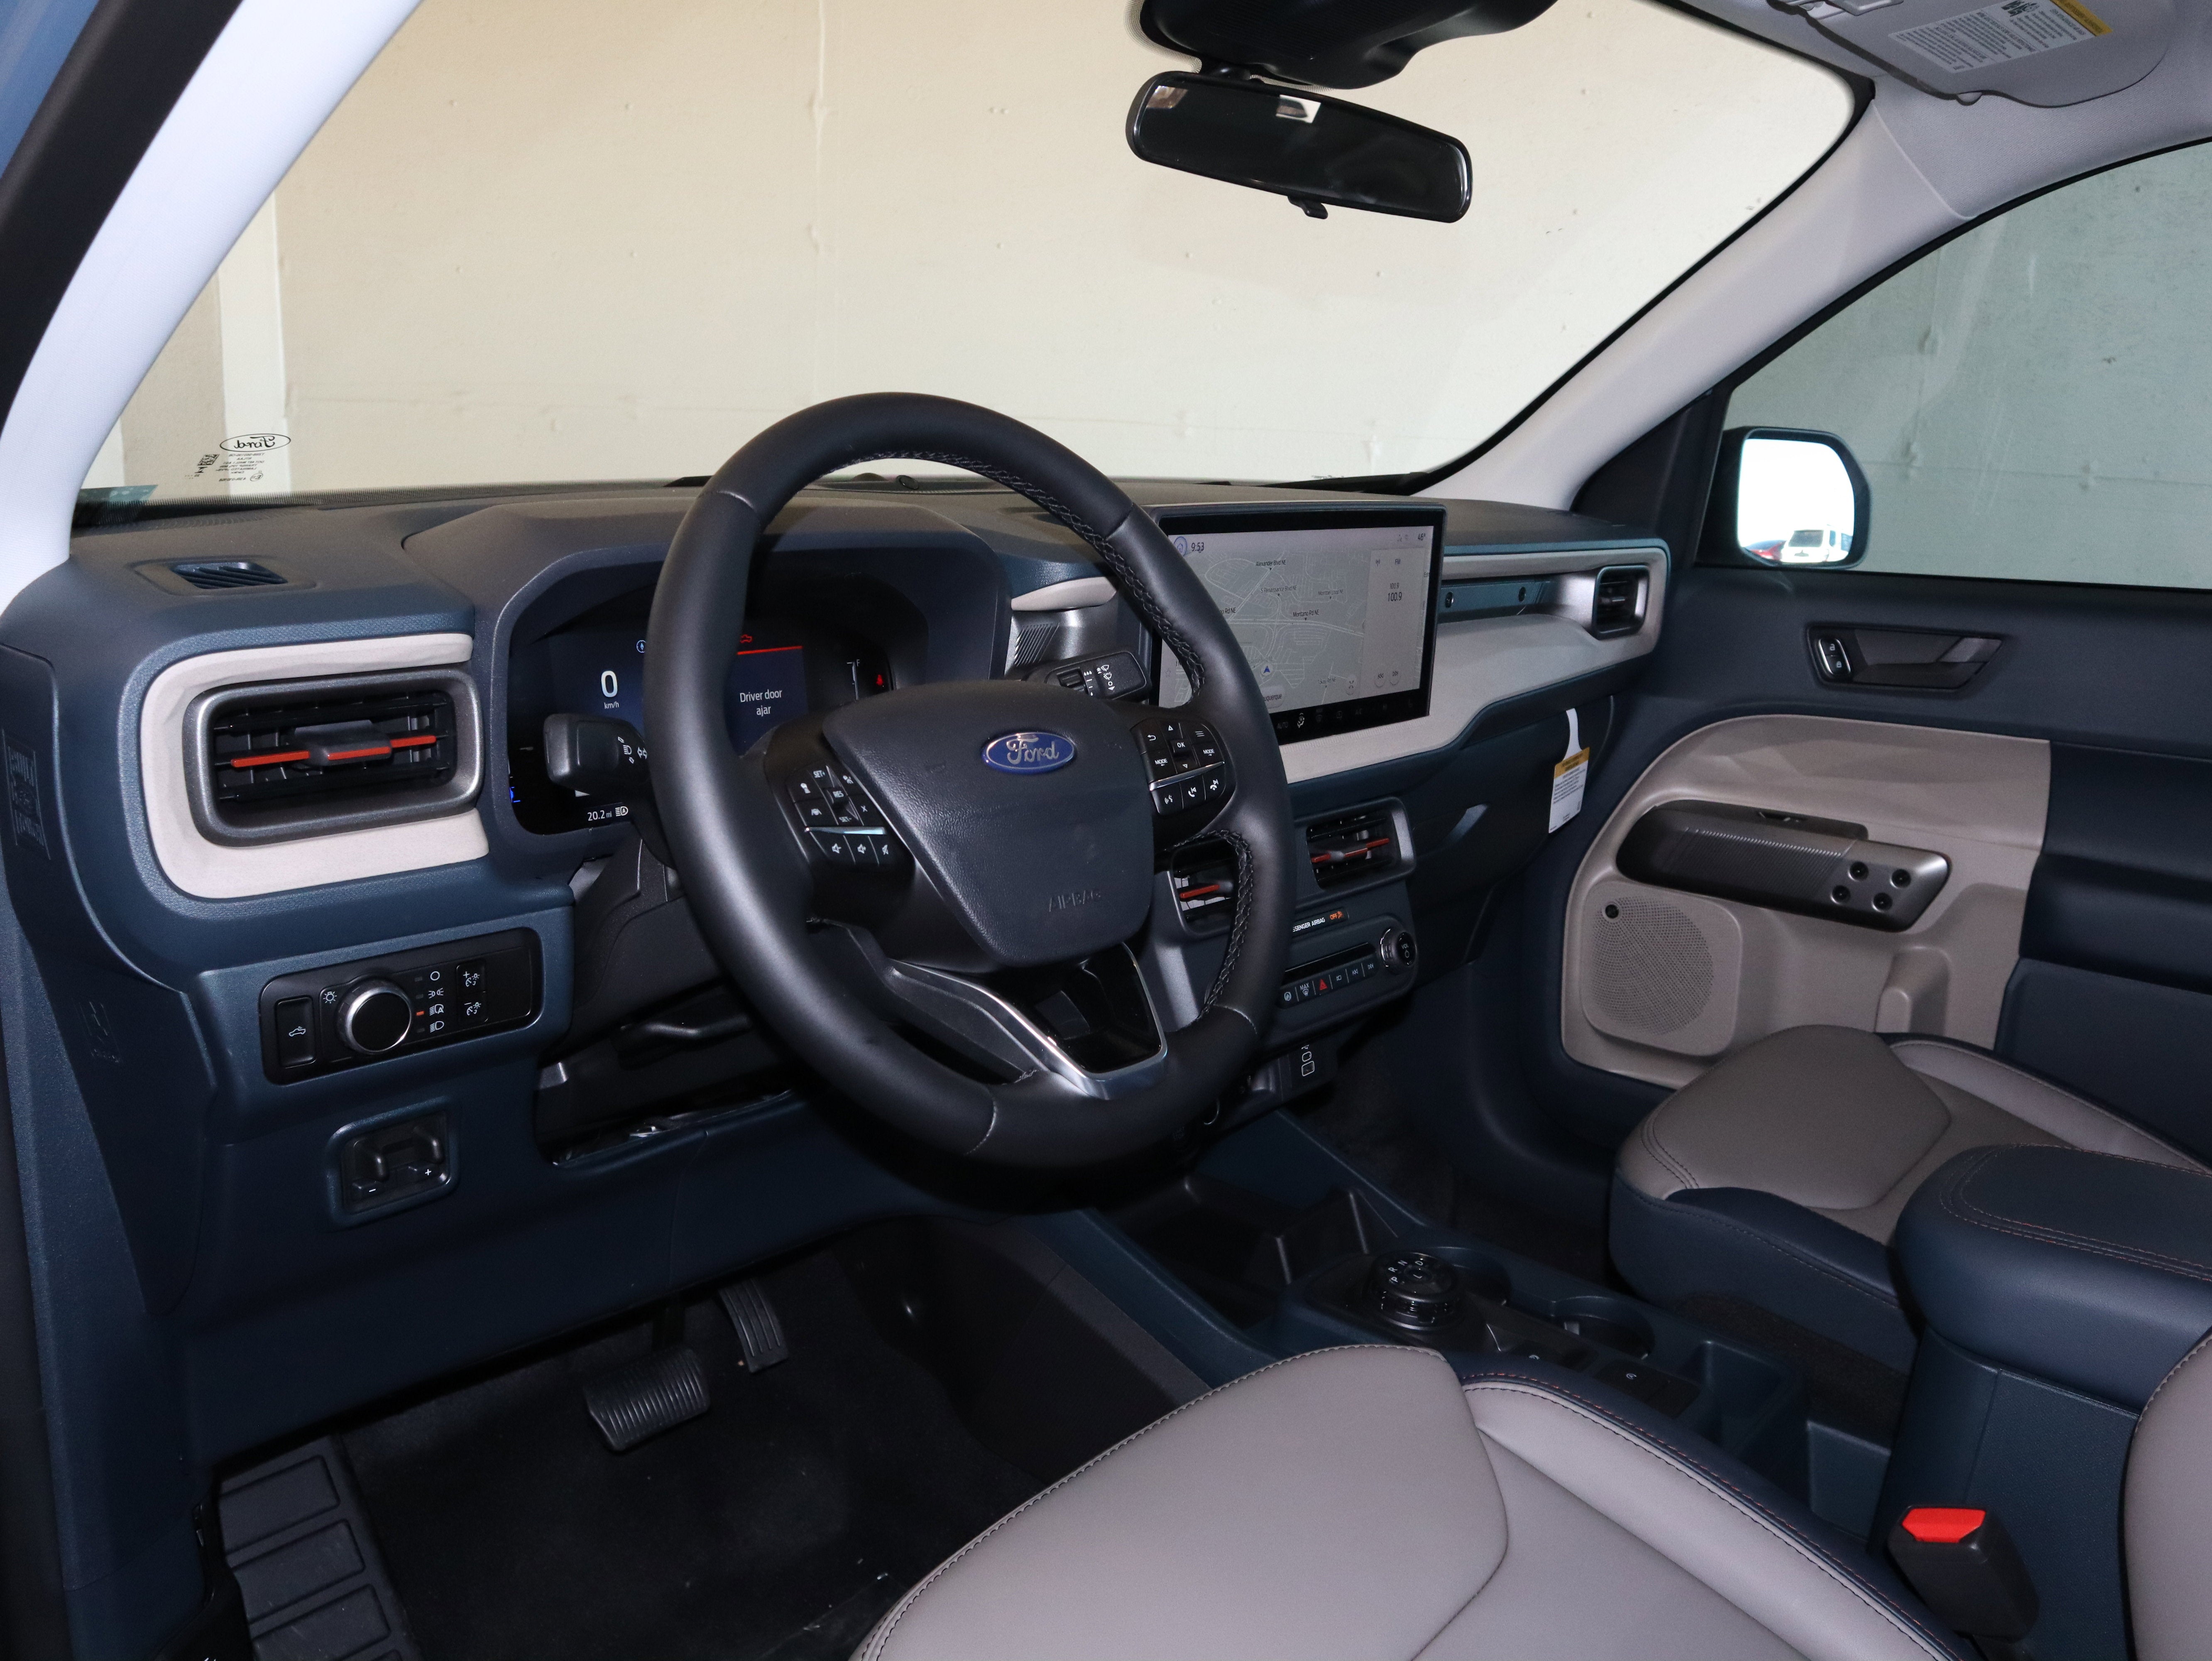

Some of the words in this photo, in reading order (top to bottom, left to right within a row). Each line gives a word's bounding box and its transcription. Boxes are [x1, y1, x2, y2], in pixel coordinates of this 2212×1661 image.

[1191, 542, 1204, 551] 9:53
[1388, 592, 1402, 602] 100.9
[601, 670, 618, 698] 0
[739, 691, 763, 703] Driver
[764, 688, 783, 700] door
[604, 701, 619, 709] km/h
[756, 705, 771, 717] ajar
[1006, 737, 1060, 765] Ford
[587, 810, 606, 821] 20.2
[1292, 921, 1311, 932] SSENGER
[1311, 917, 1326, 926] AIRBAG
[1299, 982, 1309, 991] MAX
